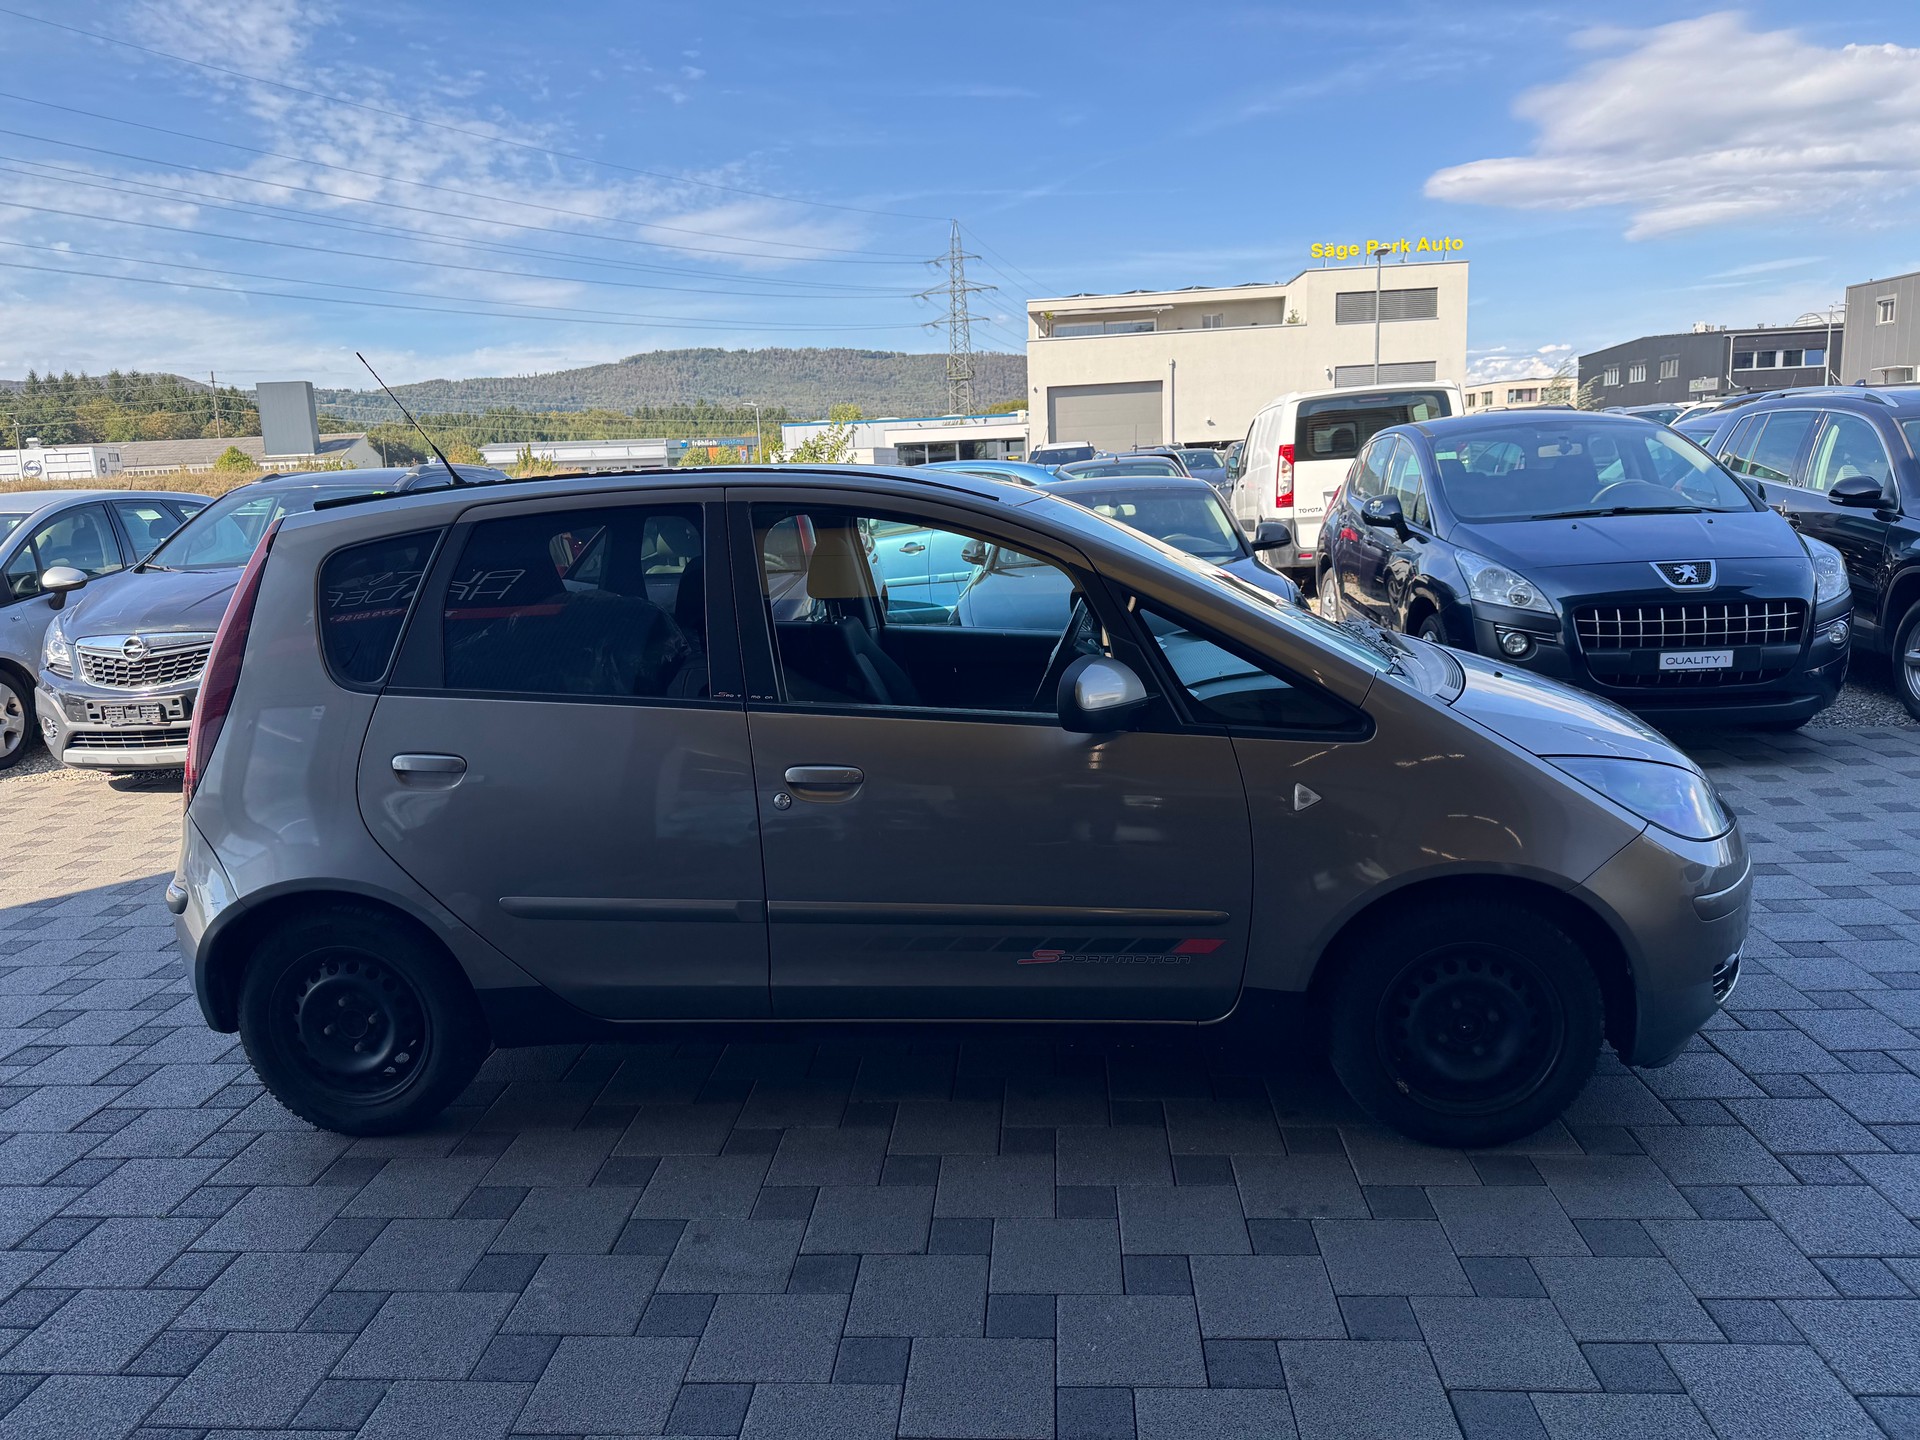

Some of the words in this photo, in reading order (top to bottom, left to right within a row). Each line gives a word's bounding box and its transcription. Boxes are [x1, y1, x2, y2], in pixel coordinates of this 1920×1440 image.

[1311, 242, 1359, 260] Säge
[1416, 236, 1463, 252] Auto
[1665, 655, 1720, 665] QUALITY
